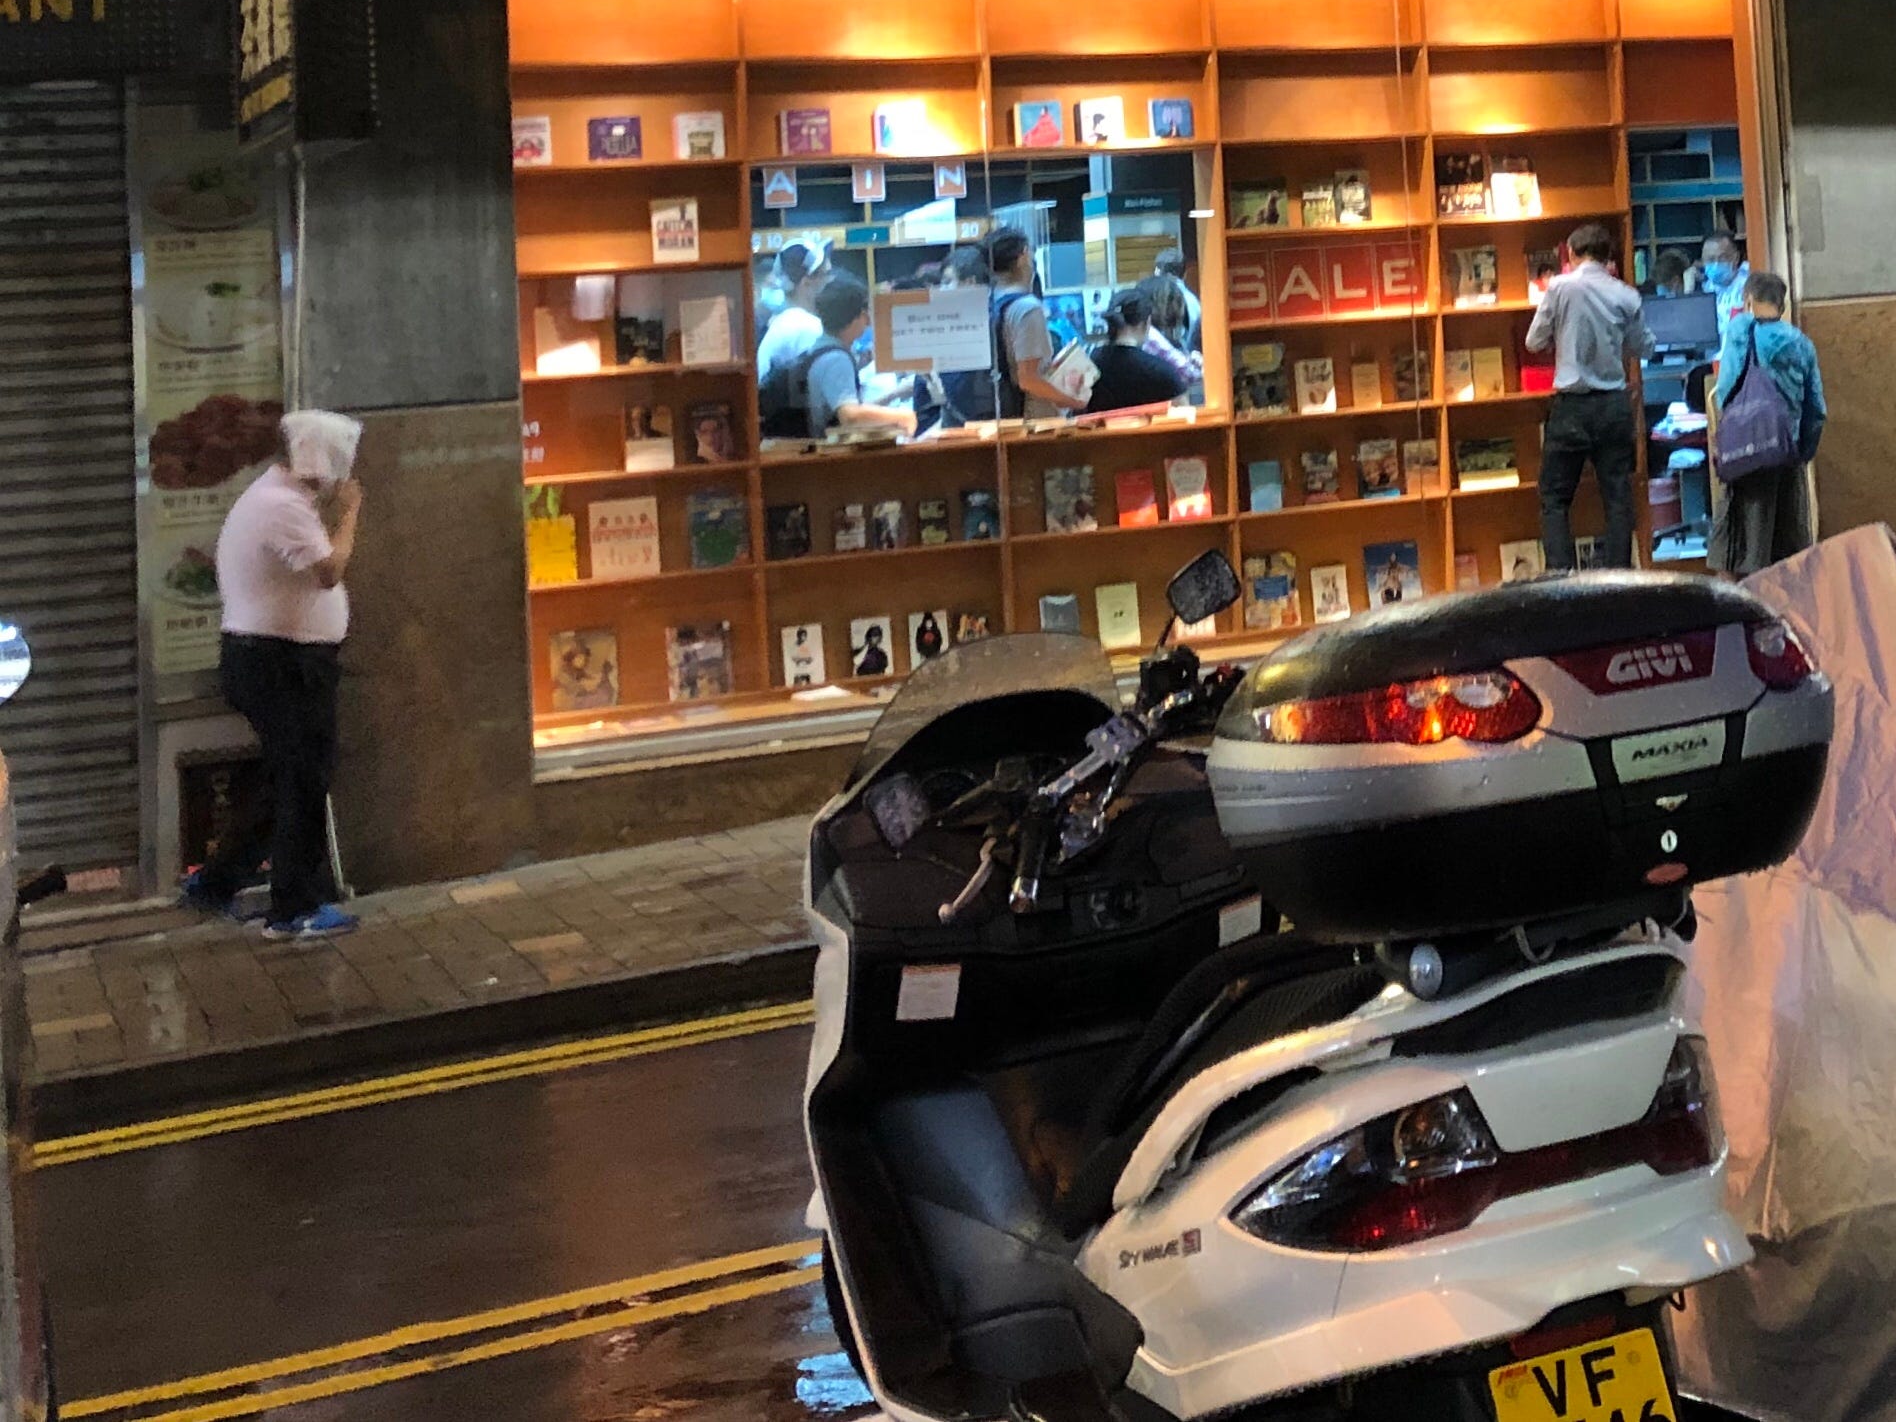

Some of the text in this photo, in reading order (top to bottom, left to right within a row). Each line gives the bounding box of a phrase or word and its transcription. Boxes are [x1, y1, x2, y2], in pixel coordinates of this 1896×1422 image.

[1229, 257, 1418, 311] SALE
[1606, 642, 1694, 685] GIVI
[1631, 736, 1709, 761] MAXIA
[1532, 1345, 1616, 1418] VF
